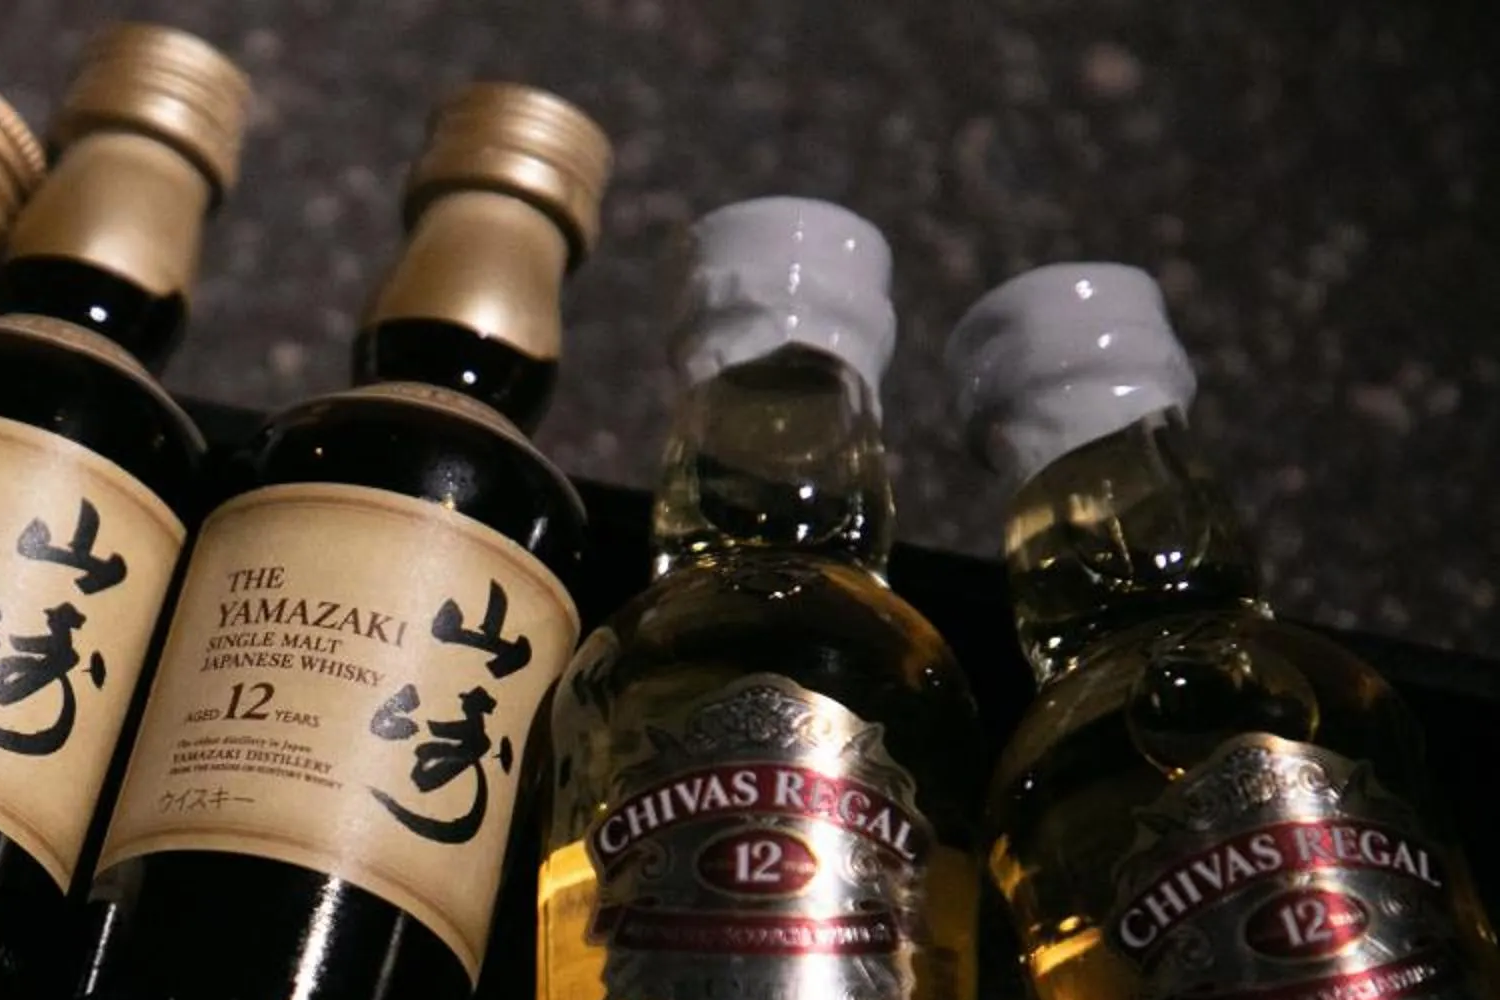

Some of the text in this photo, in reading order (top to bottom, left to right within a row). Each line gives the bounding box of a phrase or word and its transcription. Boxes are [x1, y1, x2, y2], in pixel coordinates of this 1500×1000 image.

[227, 565, 285, 593] THE
[205, 630, 344, 655] SINGLE MALT
[218, 597, 409, 649] YAMAZAKI
[199, 651, 385, 688] JAPANESE WHISKY
[184, 681, 321, 728] AGED 12 YEARS
[173, 748, 333, 775] YAMAZAKI DISTILLERY
[160, 783, 256, 814] ウイスキー
[599, 768, 918, 861] CHIVAS REGAL
[733, 840, 784, 883] 12
[1118, 825, 1443, 949] CHIVAS REGAL
[1278, 898, 1334, 948] 12
